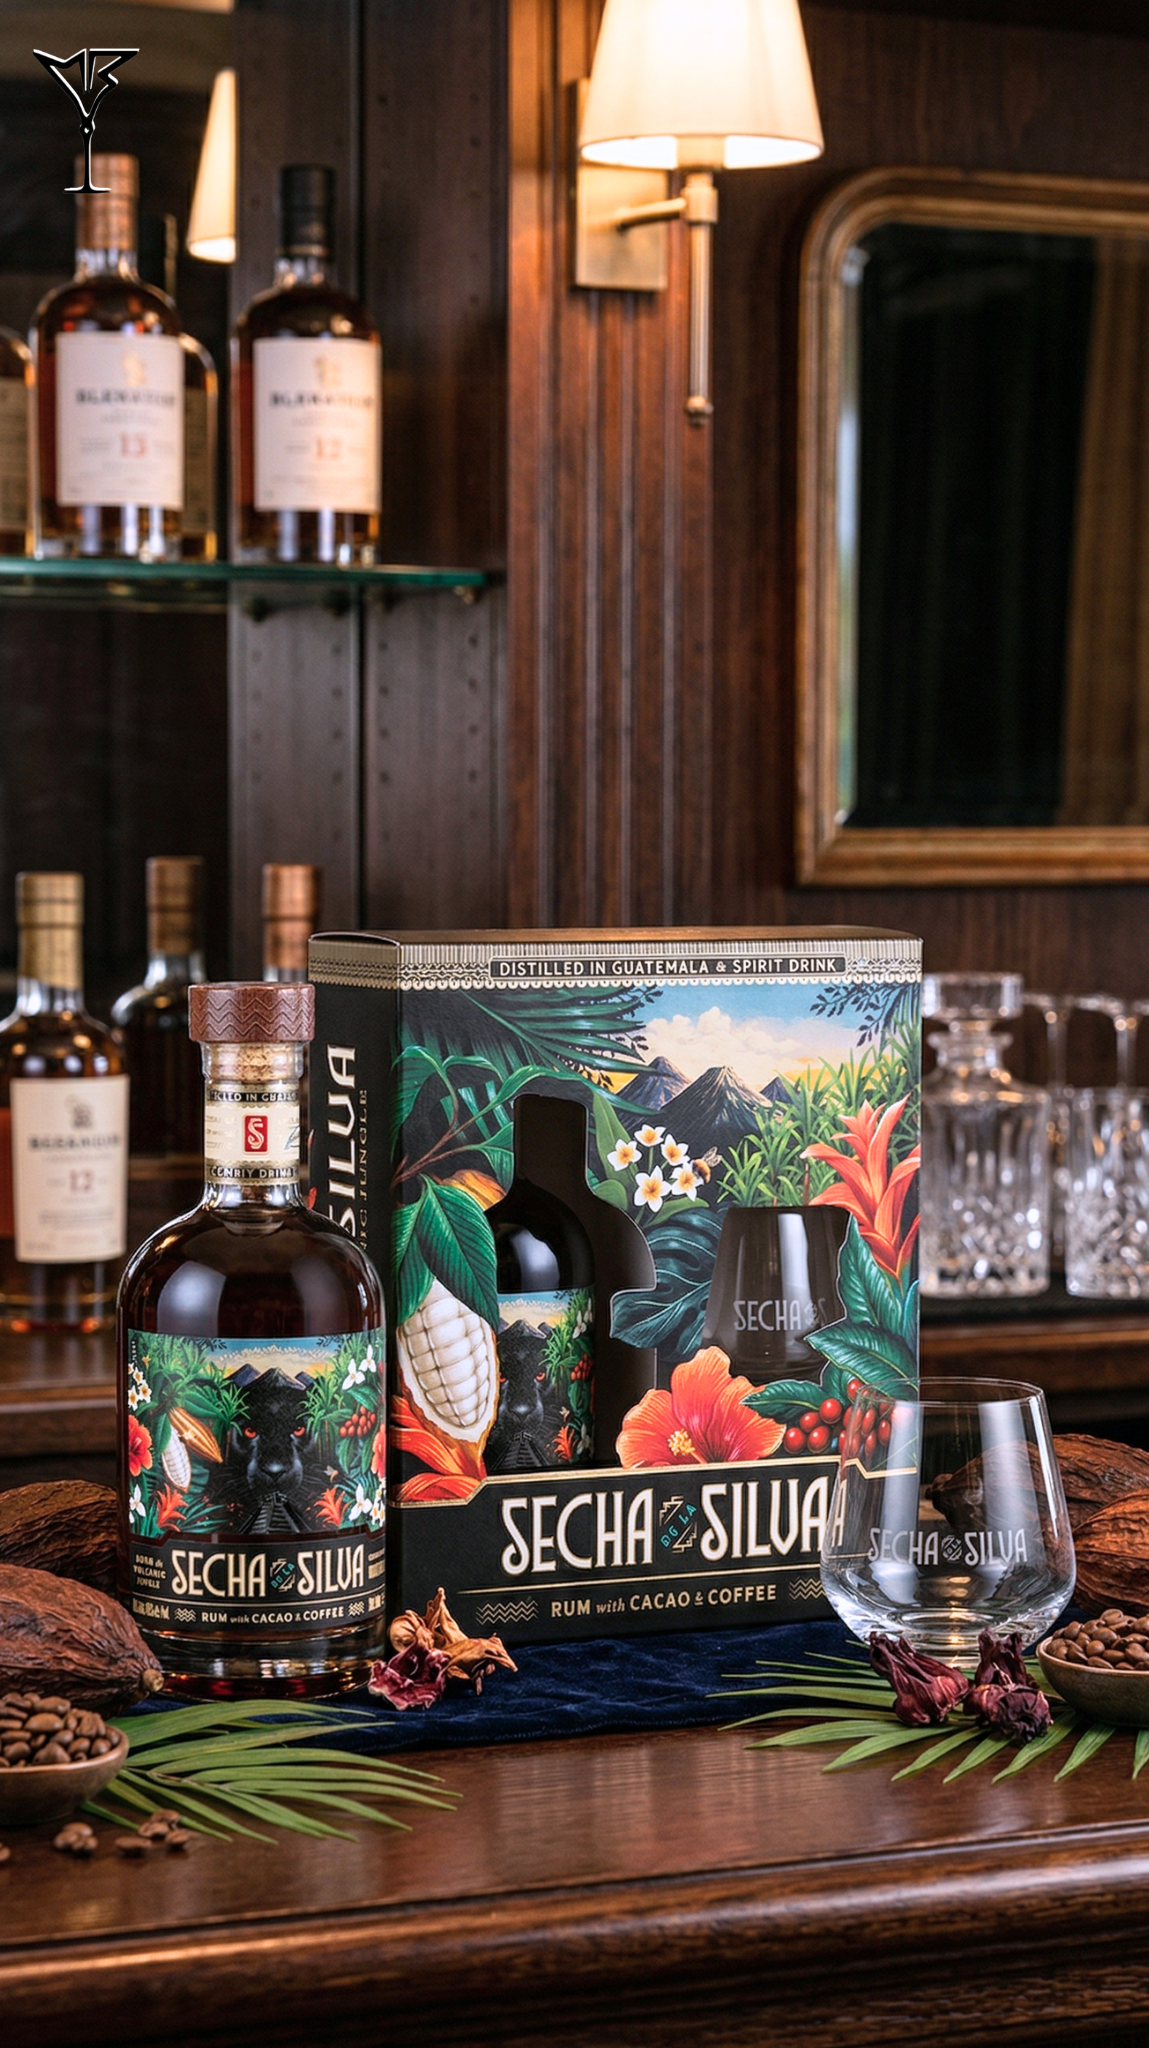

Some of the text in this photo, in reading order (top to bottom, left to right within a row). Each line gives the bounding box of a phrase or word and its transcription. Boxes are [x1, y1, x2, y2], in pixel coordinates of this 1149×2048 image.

[499, 957, 837, 977] DISTILLED IN GUATEMALA & SPIRIT DRINK
[246, 1093, 258, 1101] IN
[733, 1300, 801, 1331] SECHA
[501, 1488, 654, 1576] SECHA
[700, 1476, 829, 1561] SILVA
[868, 1527, 939, 1566] SECHA
[964, 1528, 1028, 1566] SILVA
[171, 1550, 266, 1598] SECHA
[297, 1543, 364, 1596] SILVA
[201, 1607, 228, 1623] RUM
[251, 1612, 293, 1624] CACAO
[303, 1601, 344, 1621] COFFEE
[552, 1600, 591, 1618] RUM
[596, 1598, 625, 1614] with
[629, 1589, 691, 1611] CACAO
[707, 1584, 777, 1606] COFFEE
